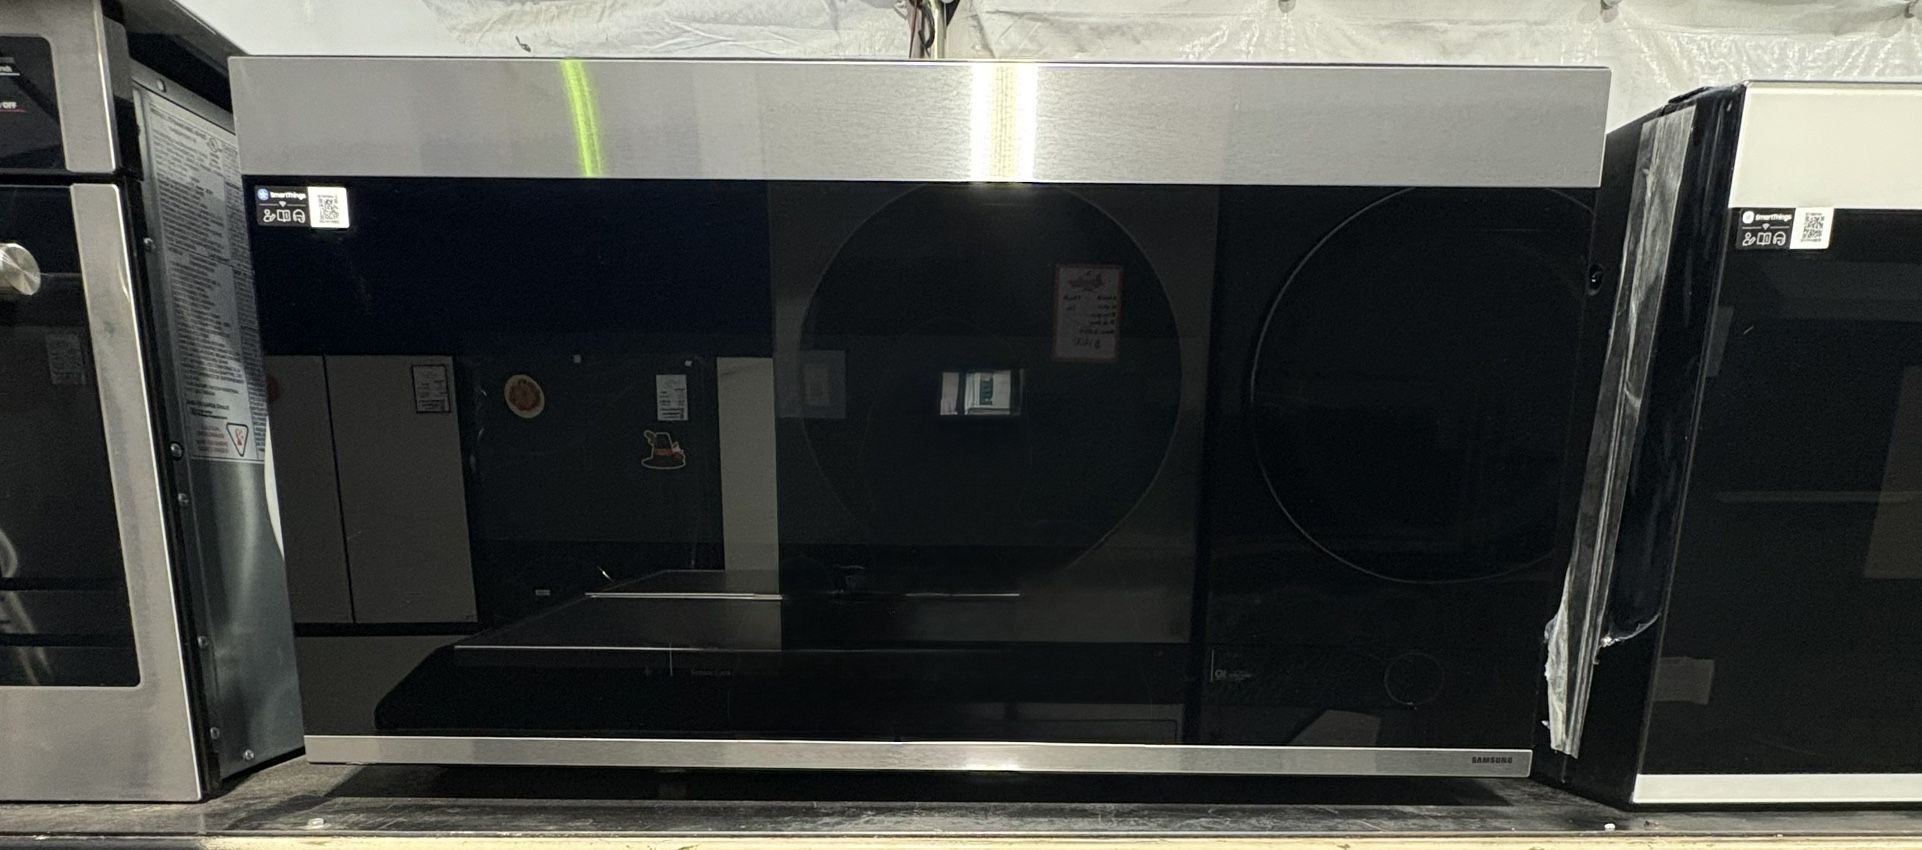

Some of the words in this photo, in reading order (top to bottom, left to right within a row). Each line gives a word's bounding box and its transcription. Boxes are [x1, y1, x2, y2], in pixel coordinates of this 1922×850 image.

[270, 191, 307, 201] SmartThings
[1755, 213, 1792, 222] SmartThings
[1471, 756, 1513, 764] SAMSUNG
